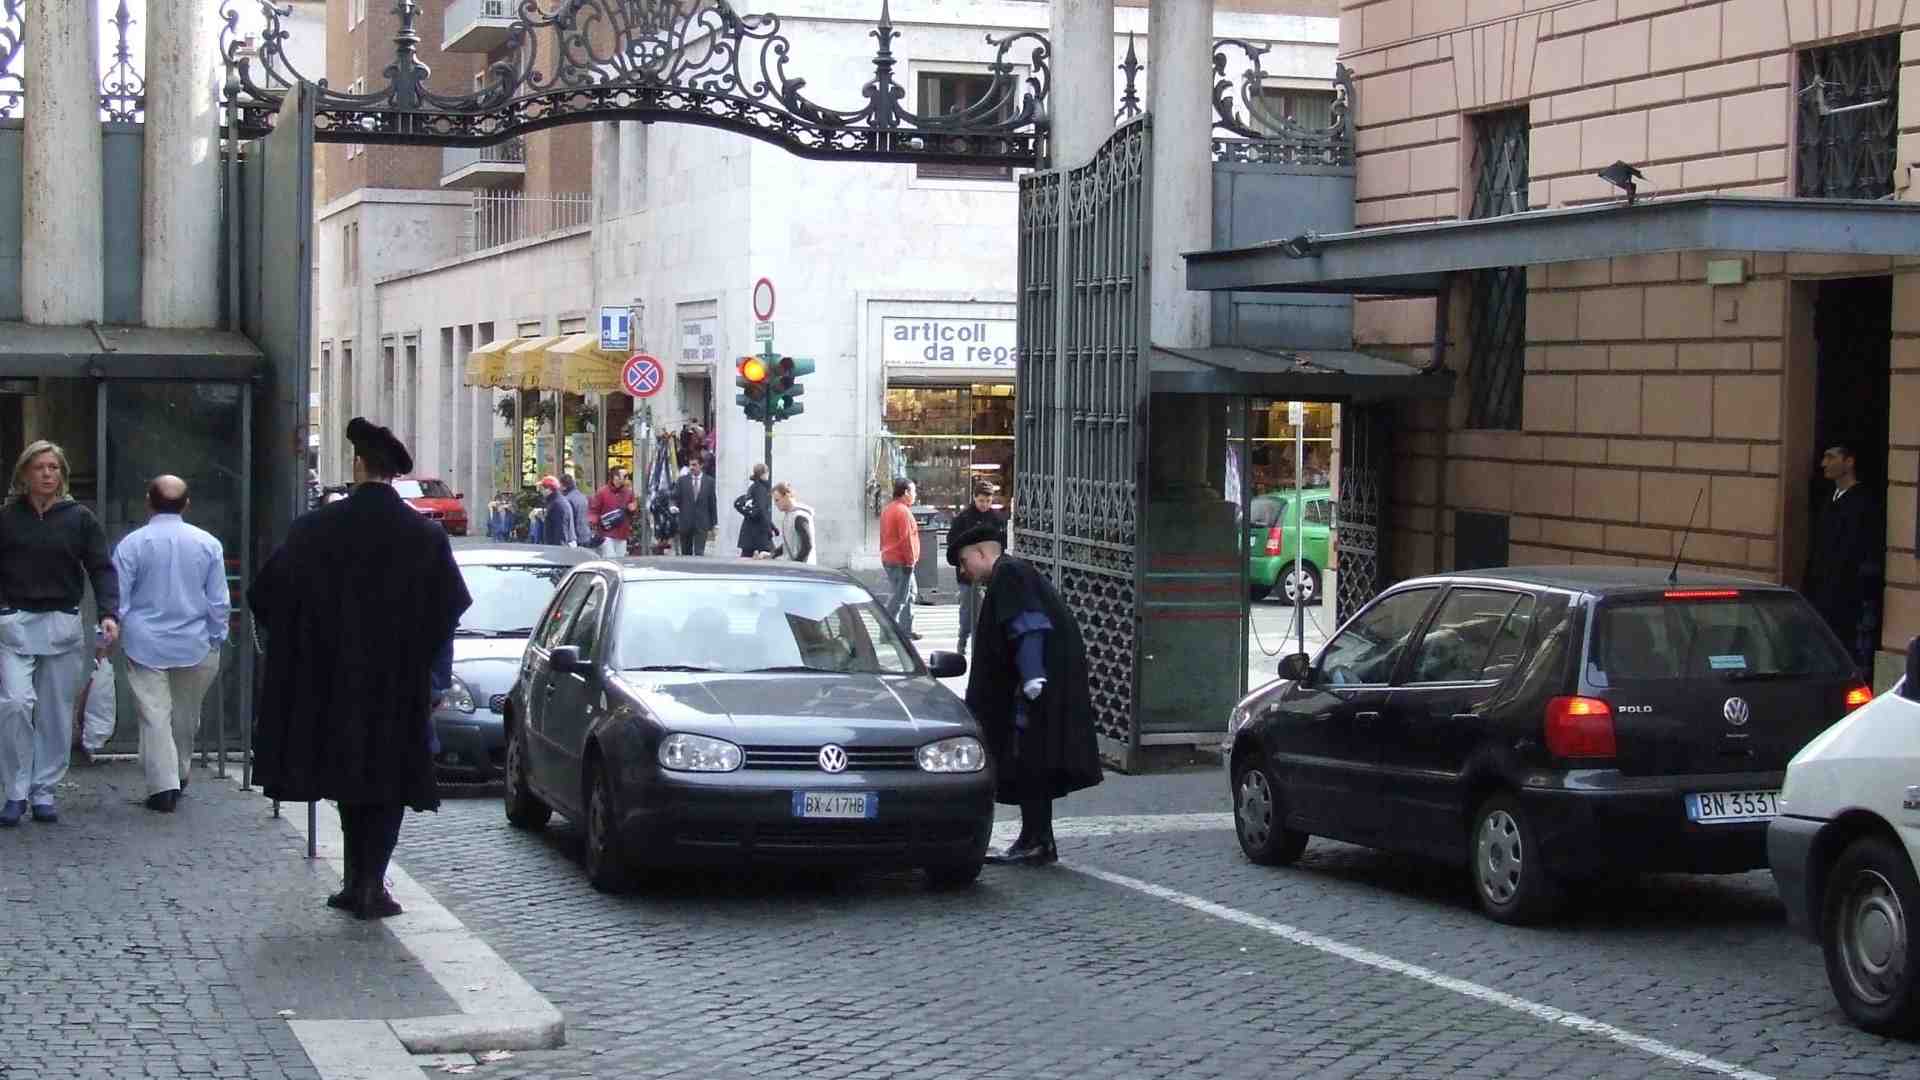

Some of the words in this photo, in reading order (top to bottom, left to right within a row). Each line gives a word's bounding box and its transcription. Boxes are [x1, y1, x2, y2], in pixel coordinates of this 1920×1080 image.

[923, 342, 955, 361] da
[1618, 704, 1653, 713] POLO
[1699, 793, 1726, 816] BN
